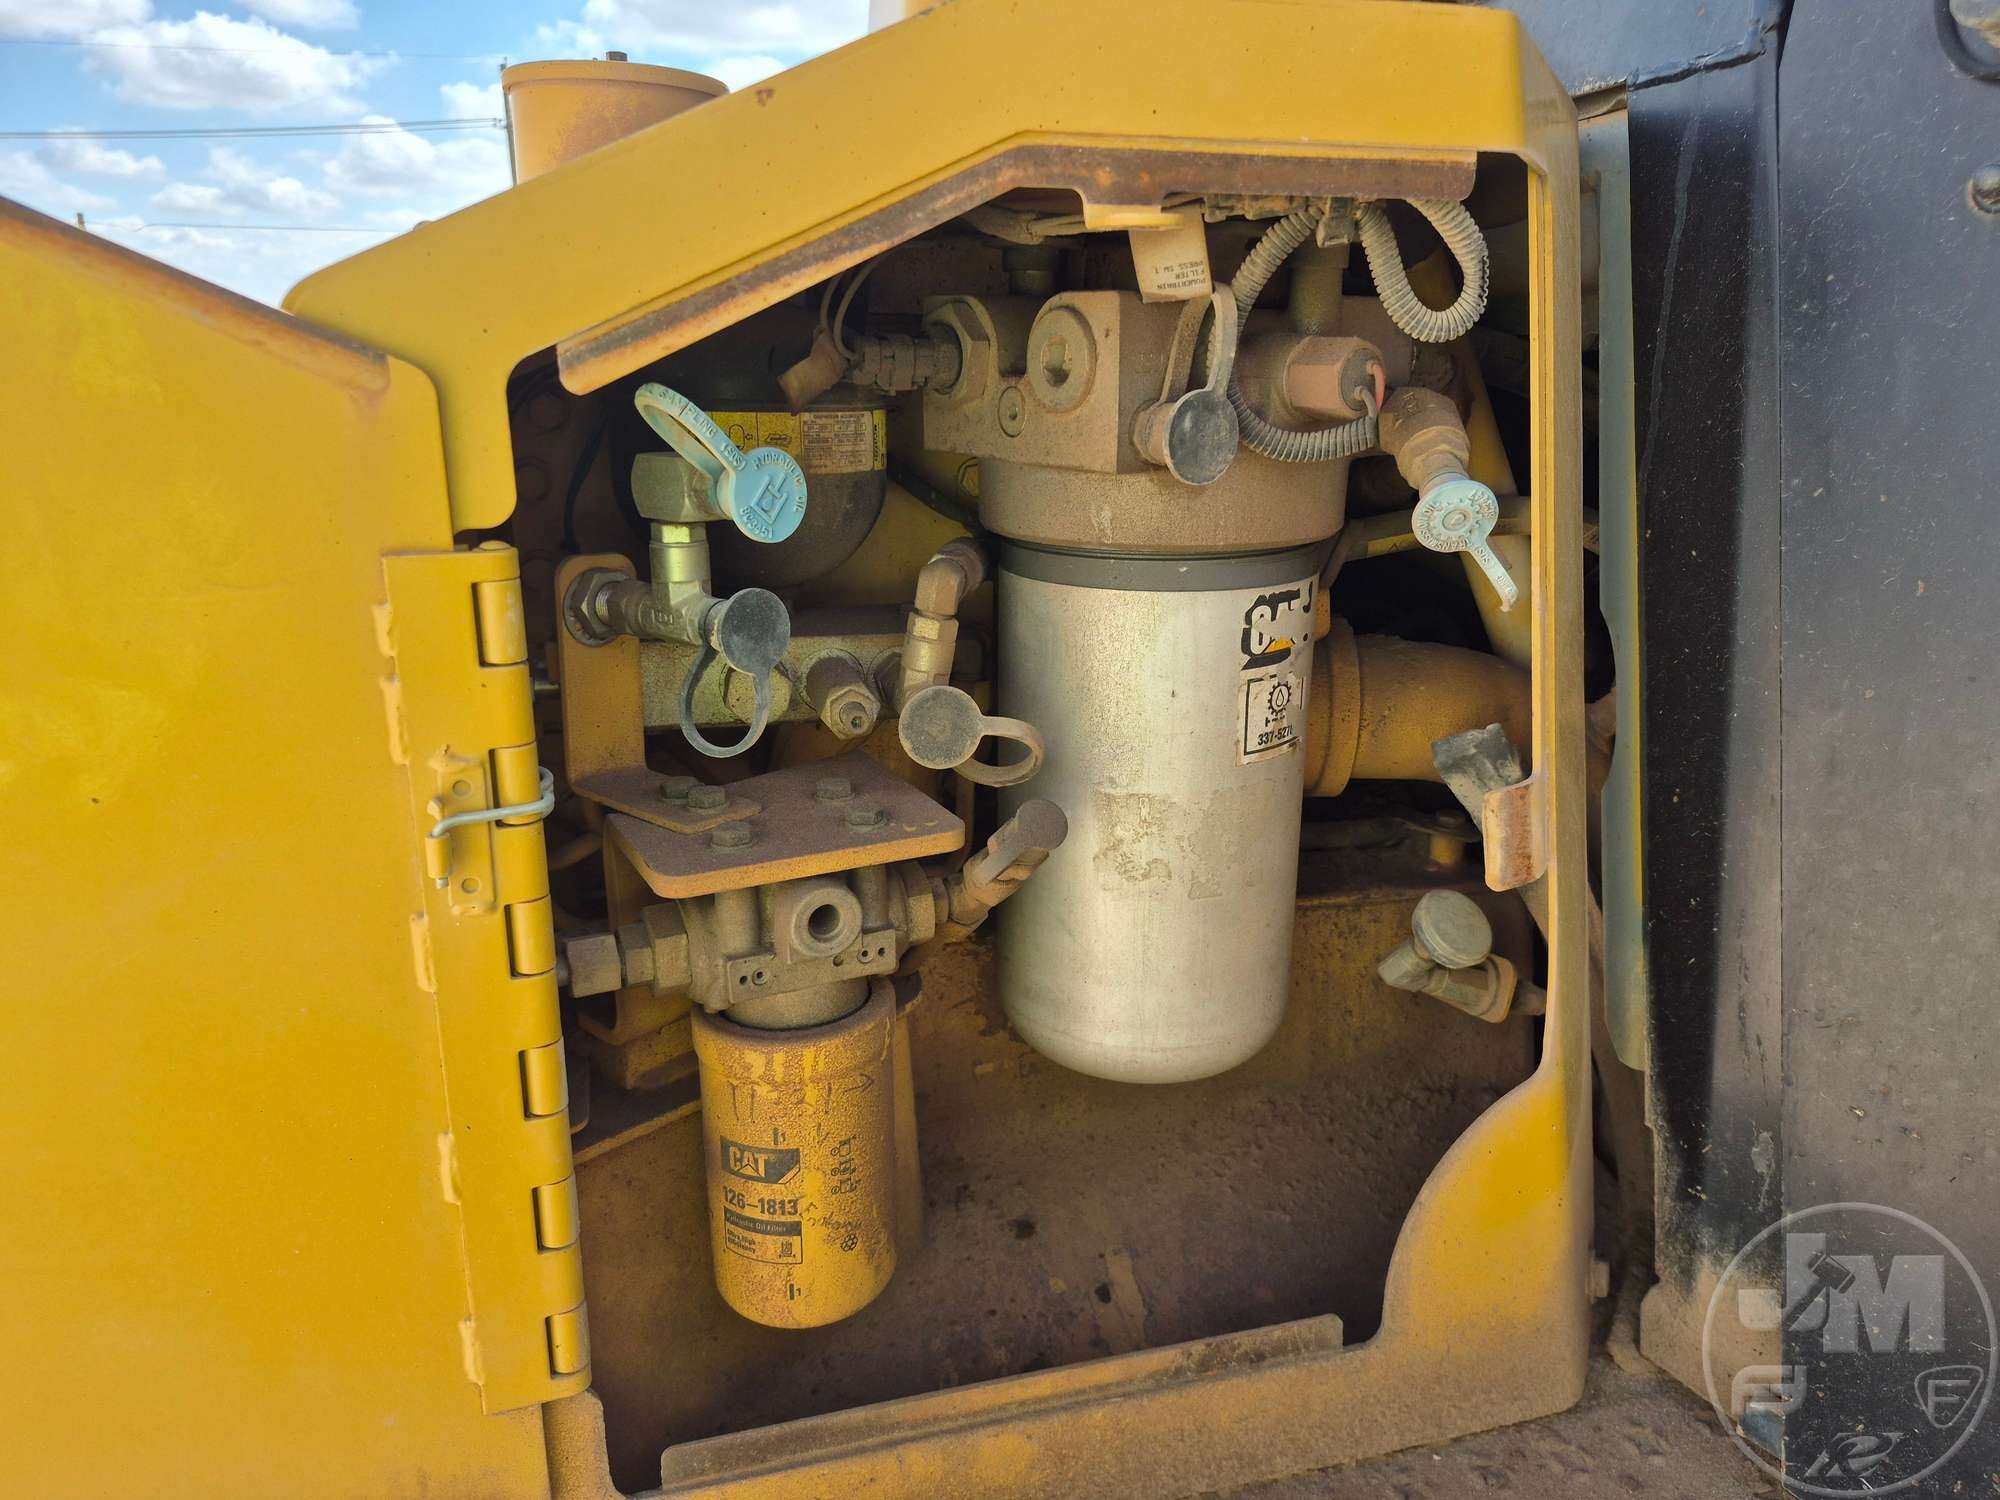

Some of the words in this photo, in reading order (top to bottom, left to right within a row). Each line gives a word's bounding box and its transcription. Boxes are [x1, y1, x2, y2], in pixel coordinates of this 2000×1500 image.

[752, 451, 804, 487] HYDRAULIC
[729, 1146, 768, 1178] CAT
[721, 1185, 799, 1216] 126-1813
